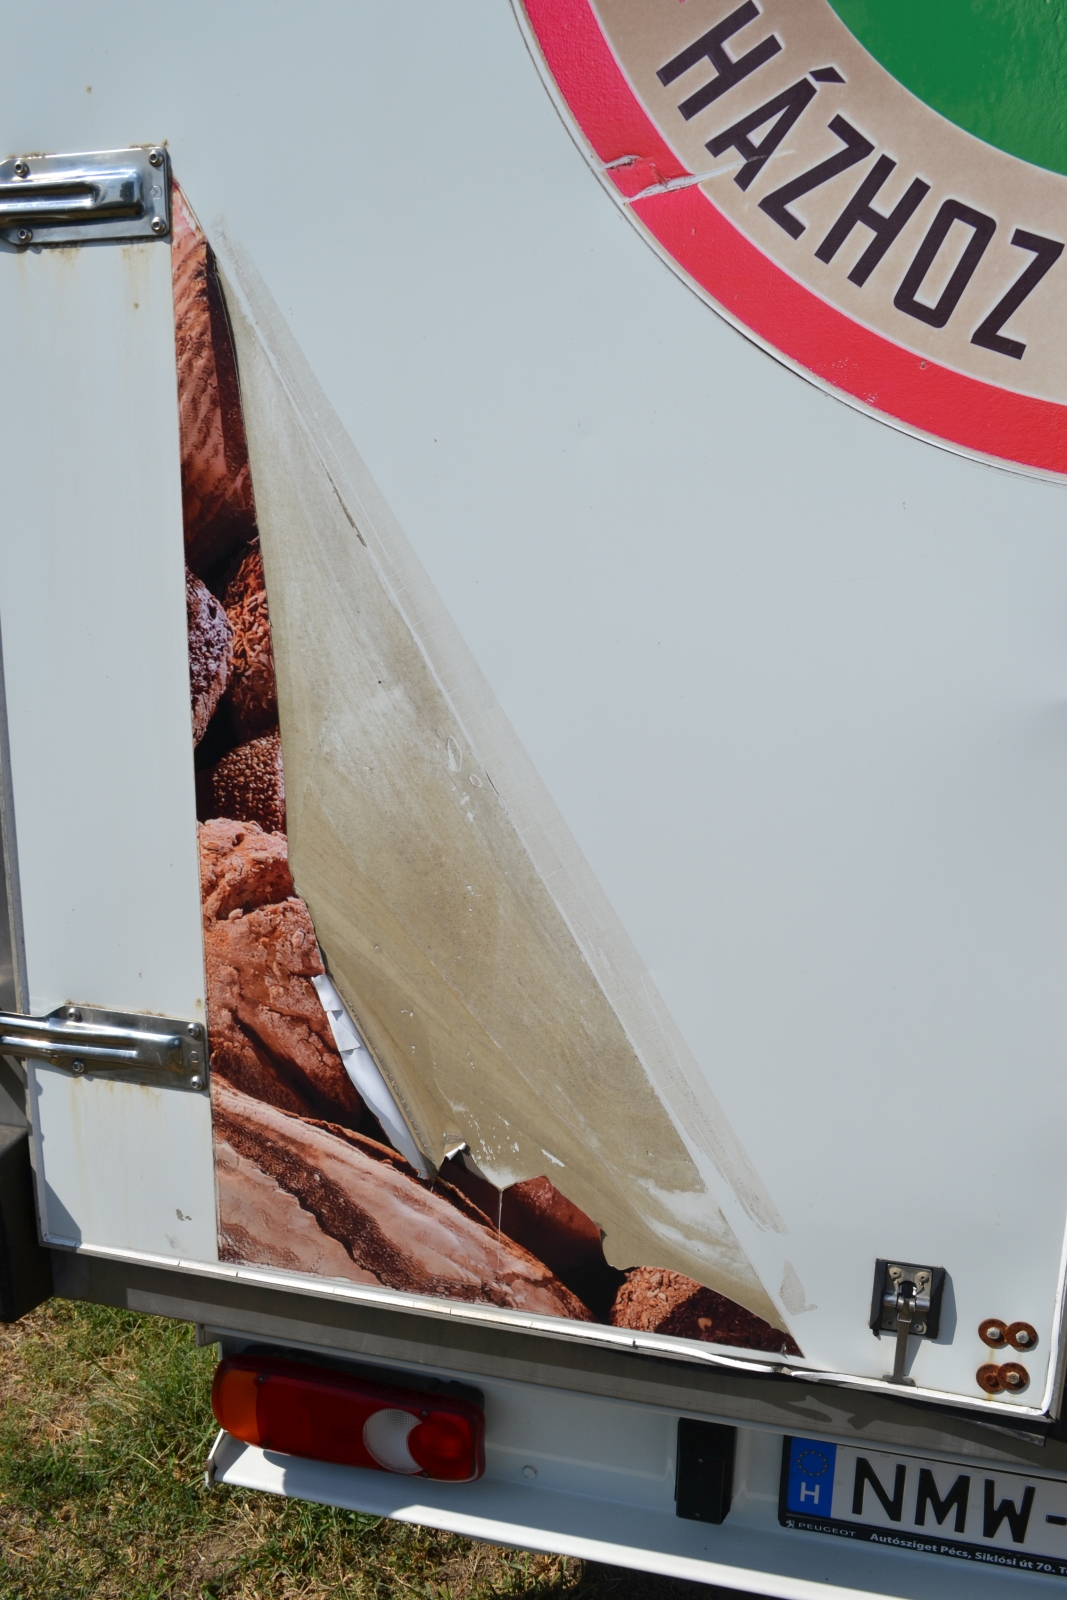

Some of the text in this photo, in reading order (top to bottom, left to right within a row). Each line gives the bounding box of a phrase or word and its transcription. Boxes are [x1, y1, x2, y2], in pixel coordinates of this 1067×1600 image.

[656, 0, 1065, 360] HÁZHOZ
[799, 1481, 820, 1505] H
[798, 1521, 857, 1538] PEUGEOT
[869, 1532, 938, 1552] Autósziget
[940, 1545, 972, 1559] Pécs,
[974, 1551, 1017, 1566] Siklósi
[1036, 1561, 1056, 1573] 70.
